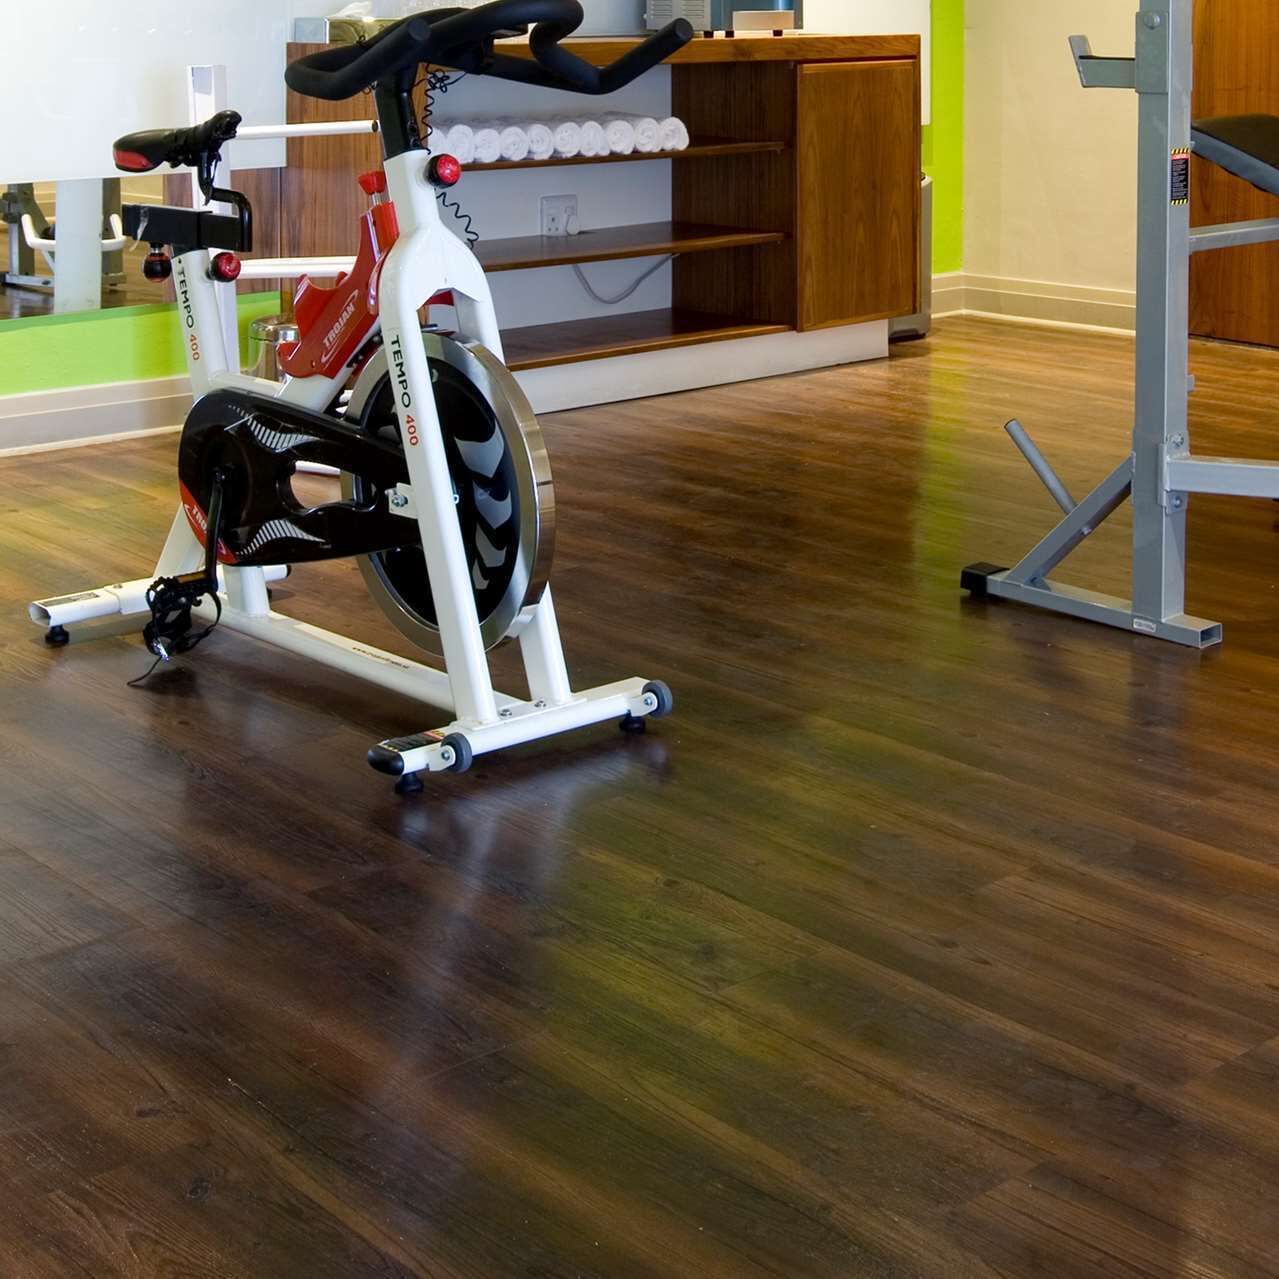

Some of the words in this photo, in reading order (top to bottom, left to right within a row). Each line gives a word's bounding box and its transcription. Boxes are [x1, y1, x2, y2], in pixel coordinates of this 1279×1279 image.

[178, 267, 195, 328] TEMPO
[190, 334, 200, 360] 400
[323, 302, 355, 349] TROJAN
[391, 334, 411, 408] TEMPO
[406, 414, 419, 446] 400
